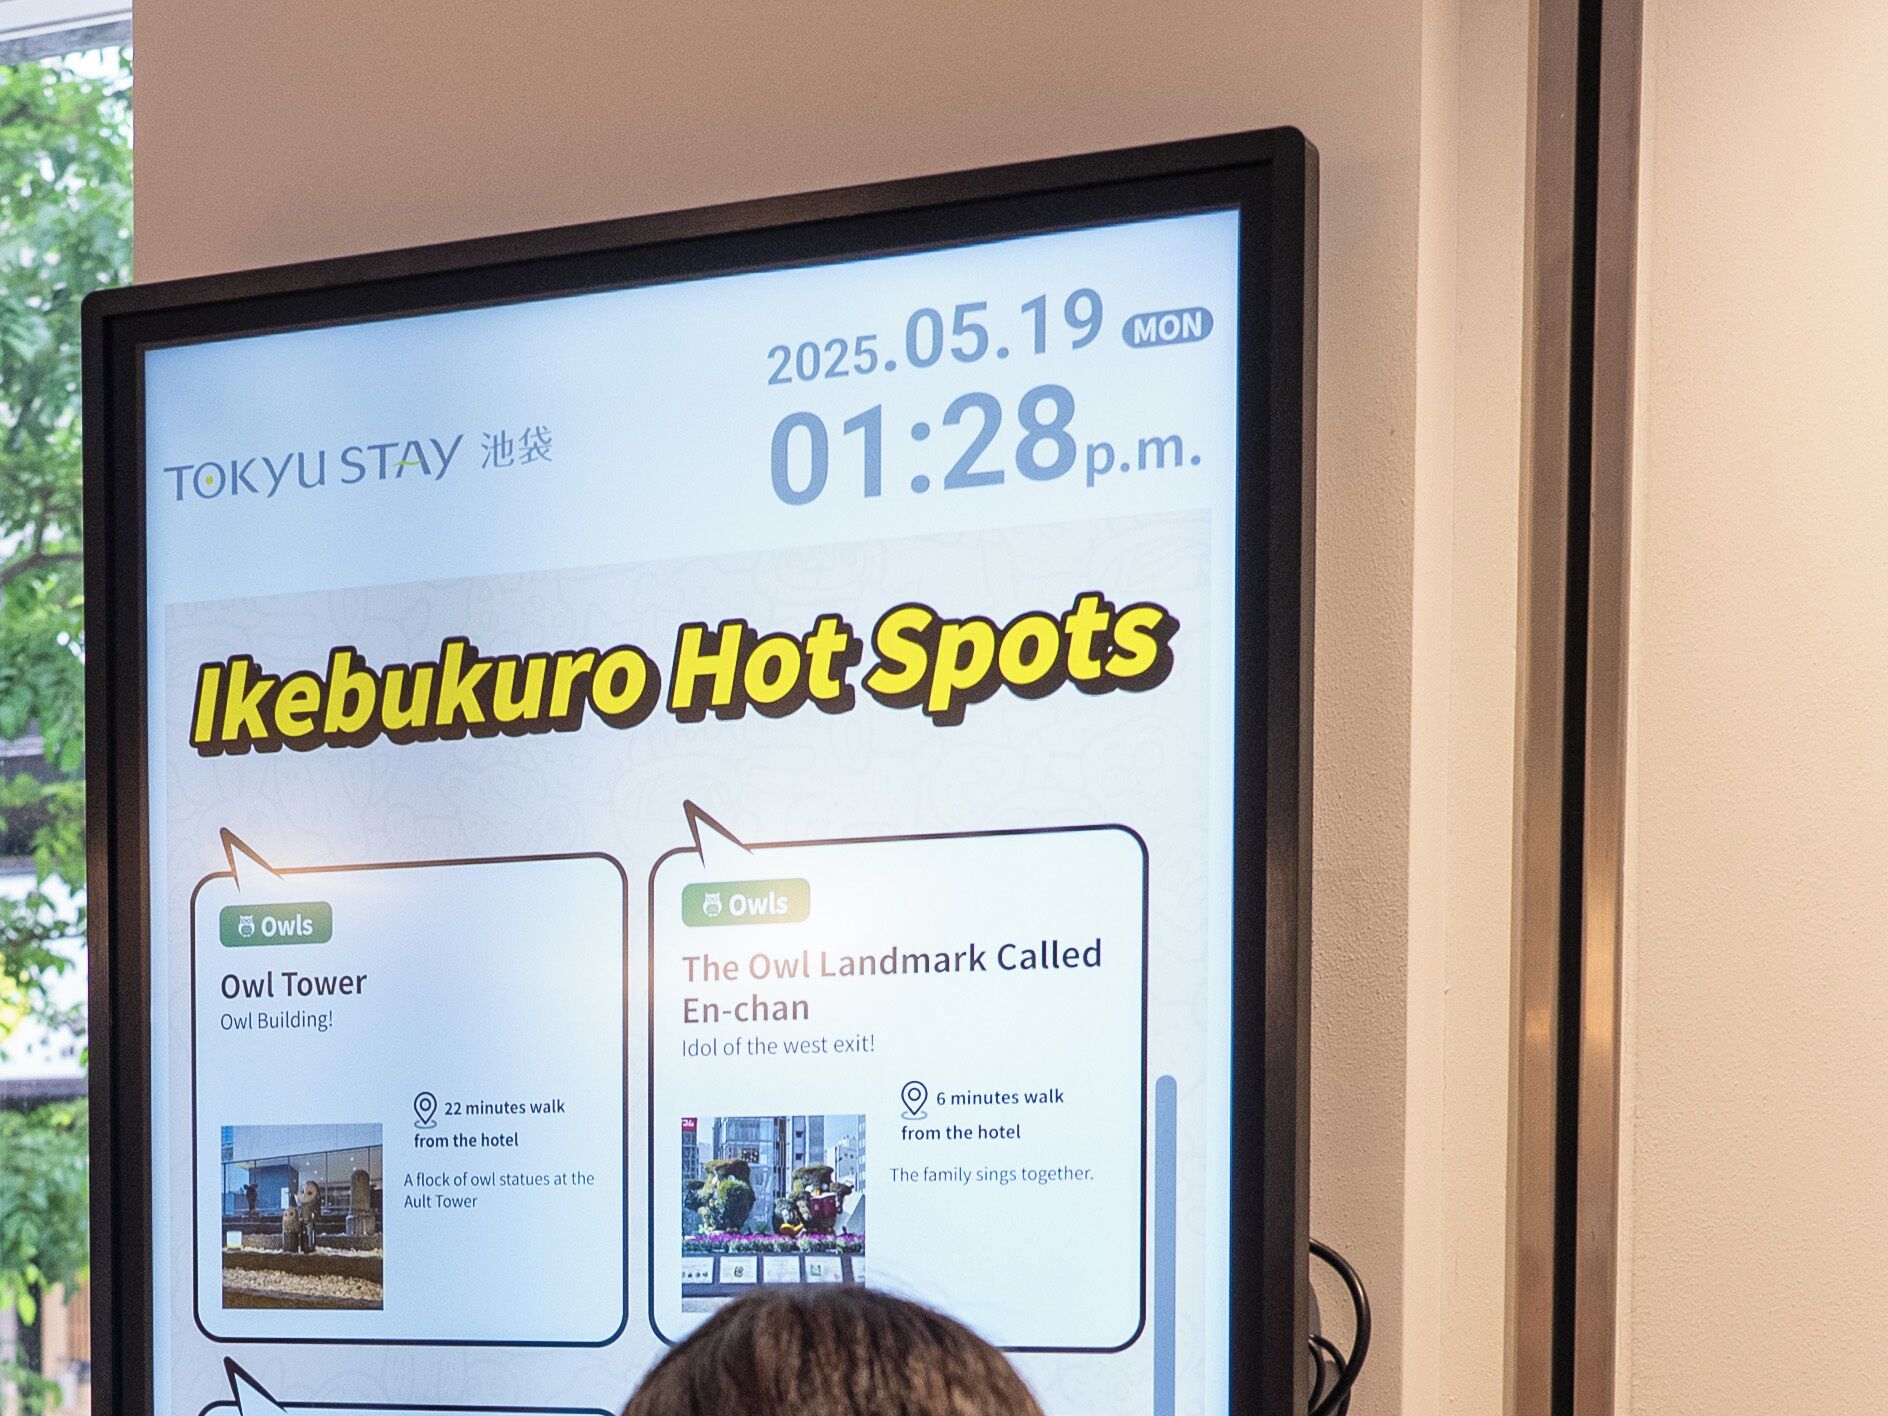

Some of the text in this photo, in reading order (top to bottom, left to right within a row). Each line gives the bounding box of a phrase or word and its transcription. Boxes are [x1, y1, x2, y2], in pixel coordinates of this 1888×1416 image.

[767, 288, 1202, 385] 2025.05.19 MON
[770, 384, 1201, 505] 01:28 p.m.
[163, 425, 553, 501] TOKYU STAY 池袋
[191, 592, 1178, 755] Ikebukuro Hot Spots
[728, 891, 788, 917] Owls
[261, 913, 314, 938] Owls
[682, 938, 1102, 982] The Owl Landmark Called
[220, 970, 367, 1000] Owl Tower
[682, 993, 810, 1024] En-chan
[220, 1010, 333, 1032] Owl Building!
[681, 1034, 874, 1057] Idol of the west exit!
[444, 1098, 565, 1116] 22 minutes walk
[936, 1087, 1064, 1106] 6 minutes walk
[413, 1132, 518, 1149] from the hotel
[901, 1124, 1021, 1140] from the hotel
[403, 1171, 595, 1187] A flock of owl statues at the
[890, 1166, 1094, 1185] The family sings together.
[403, 1192, 477, 1210] Ault Tower
